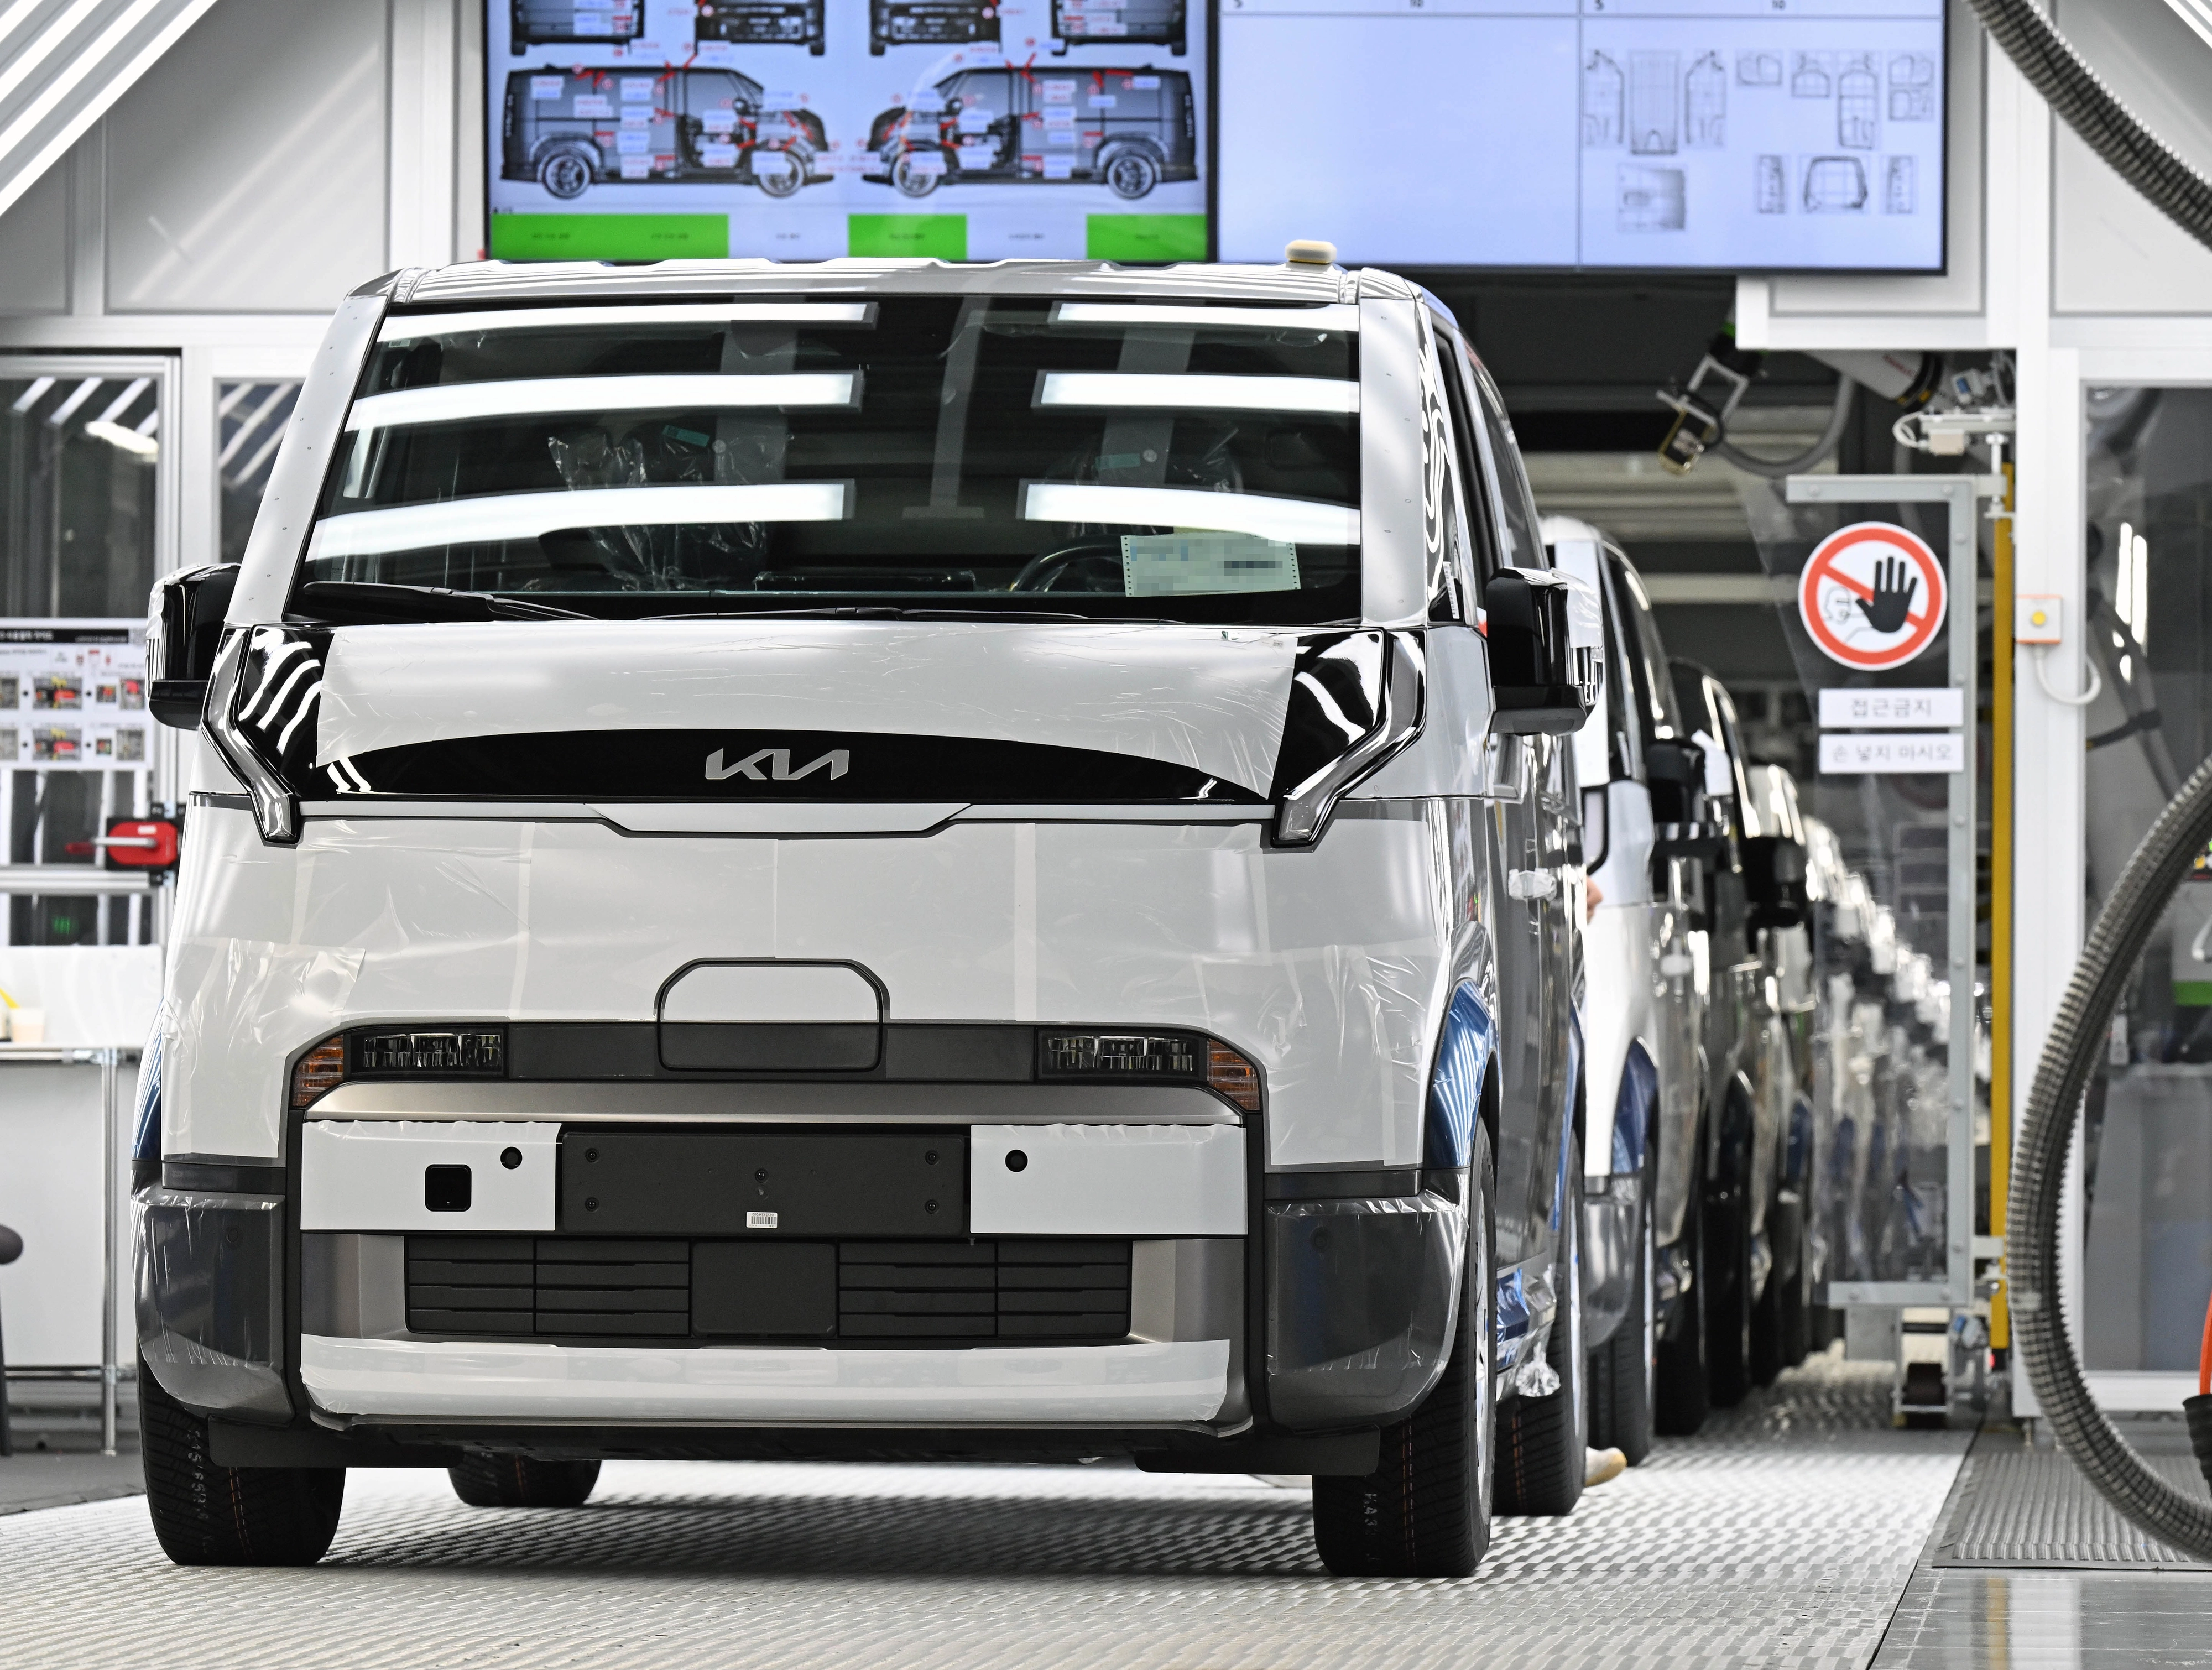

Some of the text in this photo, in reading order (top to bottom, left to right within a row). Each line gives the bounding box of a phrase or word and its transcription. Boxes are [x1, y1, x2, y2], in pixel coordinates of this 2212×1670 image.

[1852, 697, 1932, 718] 접근금지
[1833, 744, 1848, 764] 손
[1897, 743, 1953, 763] 마시오
[705, 748, 849, 781] KIA
